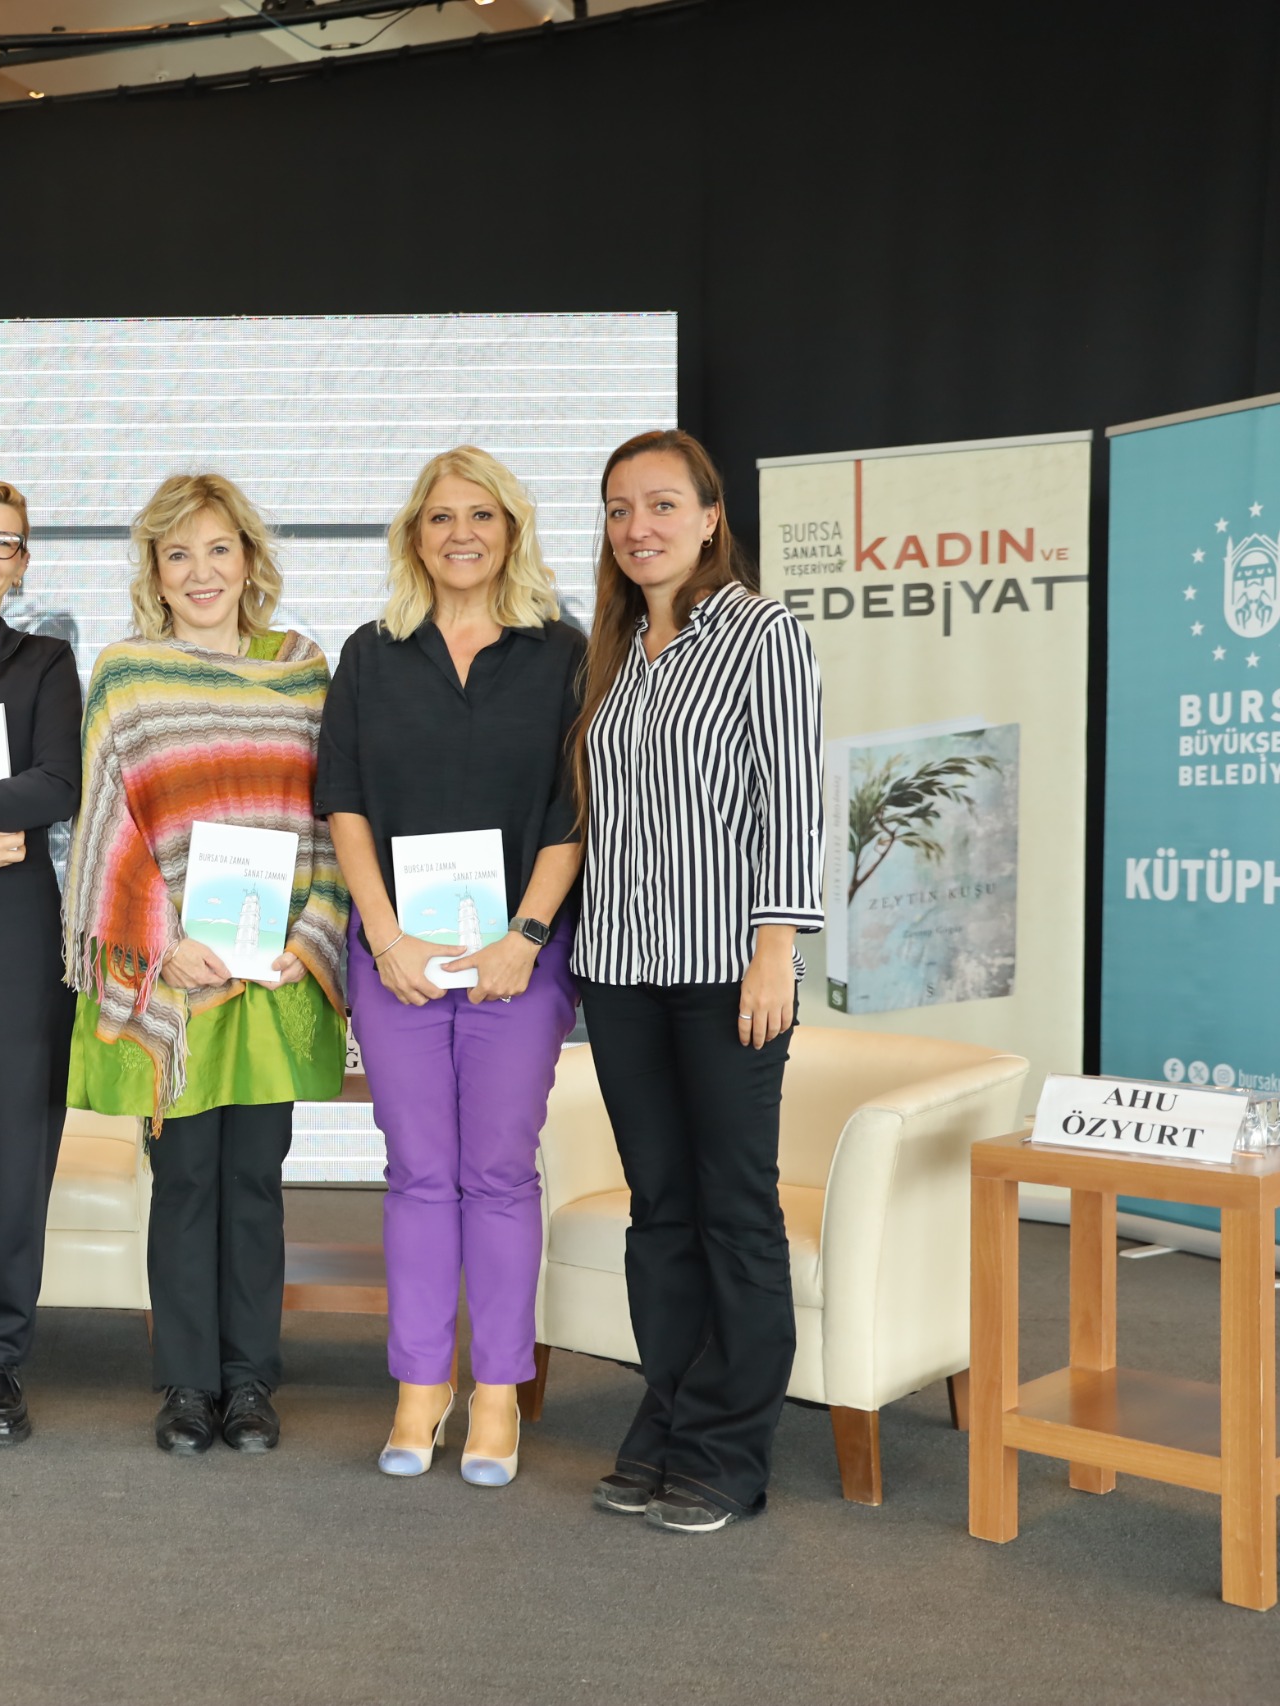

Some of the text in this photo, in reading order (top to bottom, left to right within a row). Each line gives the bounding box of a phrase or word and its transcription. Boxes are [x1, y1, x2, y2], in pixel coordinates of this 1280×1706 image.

[782, 521, 842, 543] BURSA
[783, 545, 842, 560] SANATLA
[1040, 548, 1070, 561] VE
[783, 561, 843, 578] YEŞERİYOR
[784, 574, 1088, 637] EDEBİYAT
[229, 856, 250, 866] ZAMAN
[435, 861, 456, 872] ZAMAN
[243, 868, 264, 879] SANAT
[452, 872, 472, 882] SANAT
[1102, 1087, 1179, 1112] AHU
[1062, 1110, 1204, 1149] ÖZYURT
